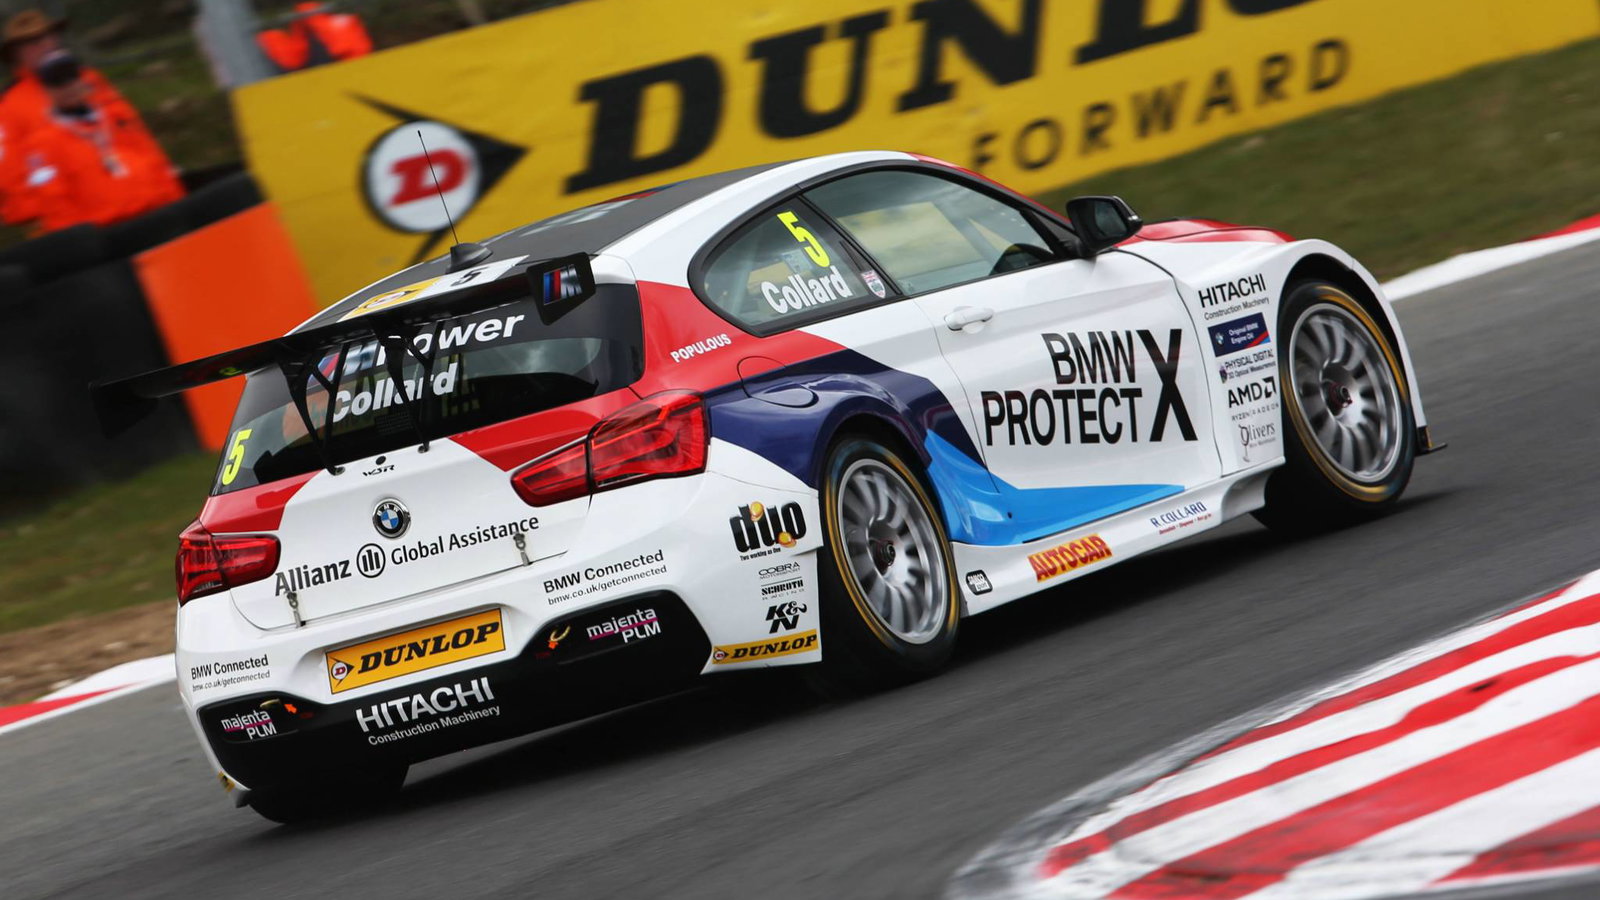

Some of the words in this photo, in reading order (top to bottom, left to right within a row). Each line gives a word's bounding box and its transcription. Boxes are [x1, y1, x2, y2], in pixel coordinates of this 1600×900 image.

[563, 0, 1316, 194] DUNL
[971, 38, 1350, 173] FORWARD
[387, 148, 471, 210] D
[777, 210, 831, 268] 5
[760, 265, 854, 314] Collard
[1198, 273, 1266, 308] HITACHI
[1204, 304, 1242, 320] Construction
[670, 333, 733, 364] POPULOUS
[1041, 330, 1136, 385] BMW
[1136, 328, 1198, 442] X
[1229, 382, 1263, 408] AMD
[980, 387, 1143, 446] PROTECT
[222, 429, 252, 485] 5
[729, 501, 807, 553] duo
[275, 557, 351, 596] Allianz
[391, 536, 445, 565] Global
[449, 516, 540, 551] Assistance
[543, 571, 581, 593] BMW
[584, 549, 664, 581] Connected
[758, 561, 801, 576] COBRA
[1029, 534, 1113, 580] AUTOCAR
[548, 565, 668, 606] bmw.co.uk/getconnected
[761, 579, 804, 596] SCHROTH
[586, 608, 657, 637] majenta
[622, 620, 661, 643] PLM
[191, 664, 212, 680] BMW
[213, 654, 269, 675] Connected
[358, 621, 500, 674] DUNLOP
[731, 634, 817, 659] DUNLOP
[192, 669, 271, 692] bmw.co.uk/getconnected
[221, 709, 271, 731] majenta
[355, 677, 495, 733] HITACHI
[368, 721, 441, 746] Construction
[441, 705, 501, 727] Machinery
[246, 721, 277, 739] PLM
